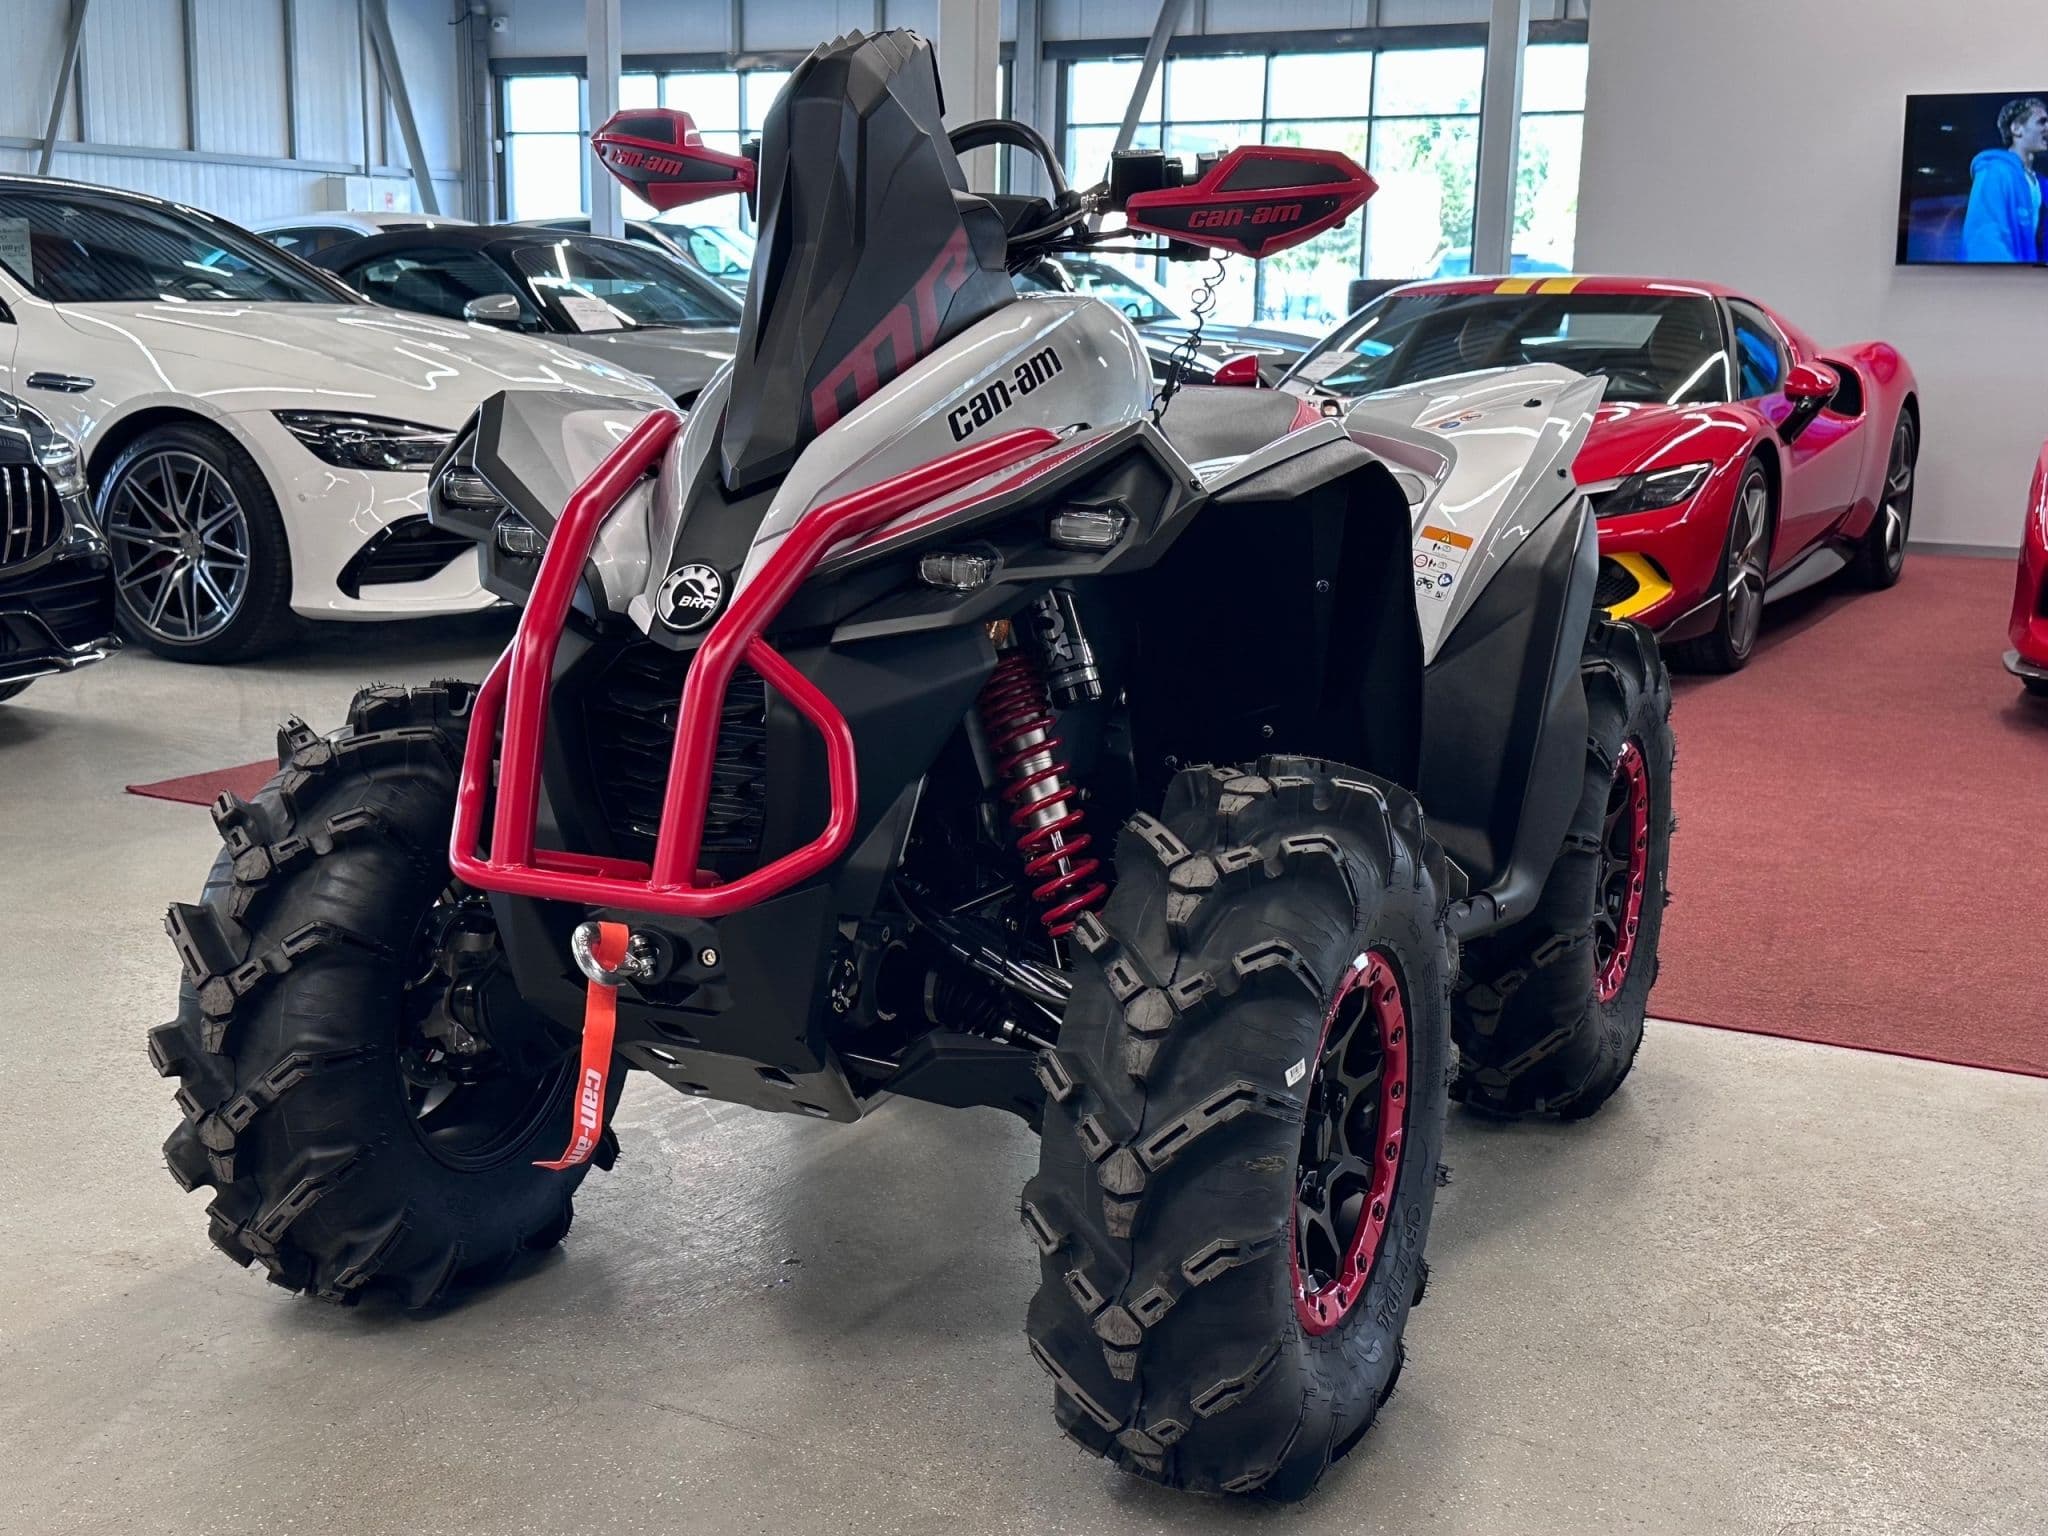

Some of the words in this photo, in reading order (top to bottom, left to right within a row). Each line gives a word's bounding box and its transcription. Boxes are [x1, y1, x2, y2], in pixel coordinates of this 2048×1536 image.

[1188, 204, 1303, 228] can-am
[948, 346, 1064, 442] can-am
[678, 595, 715, 609] BRP
